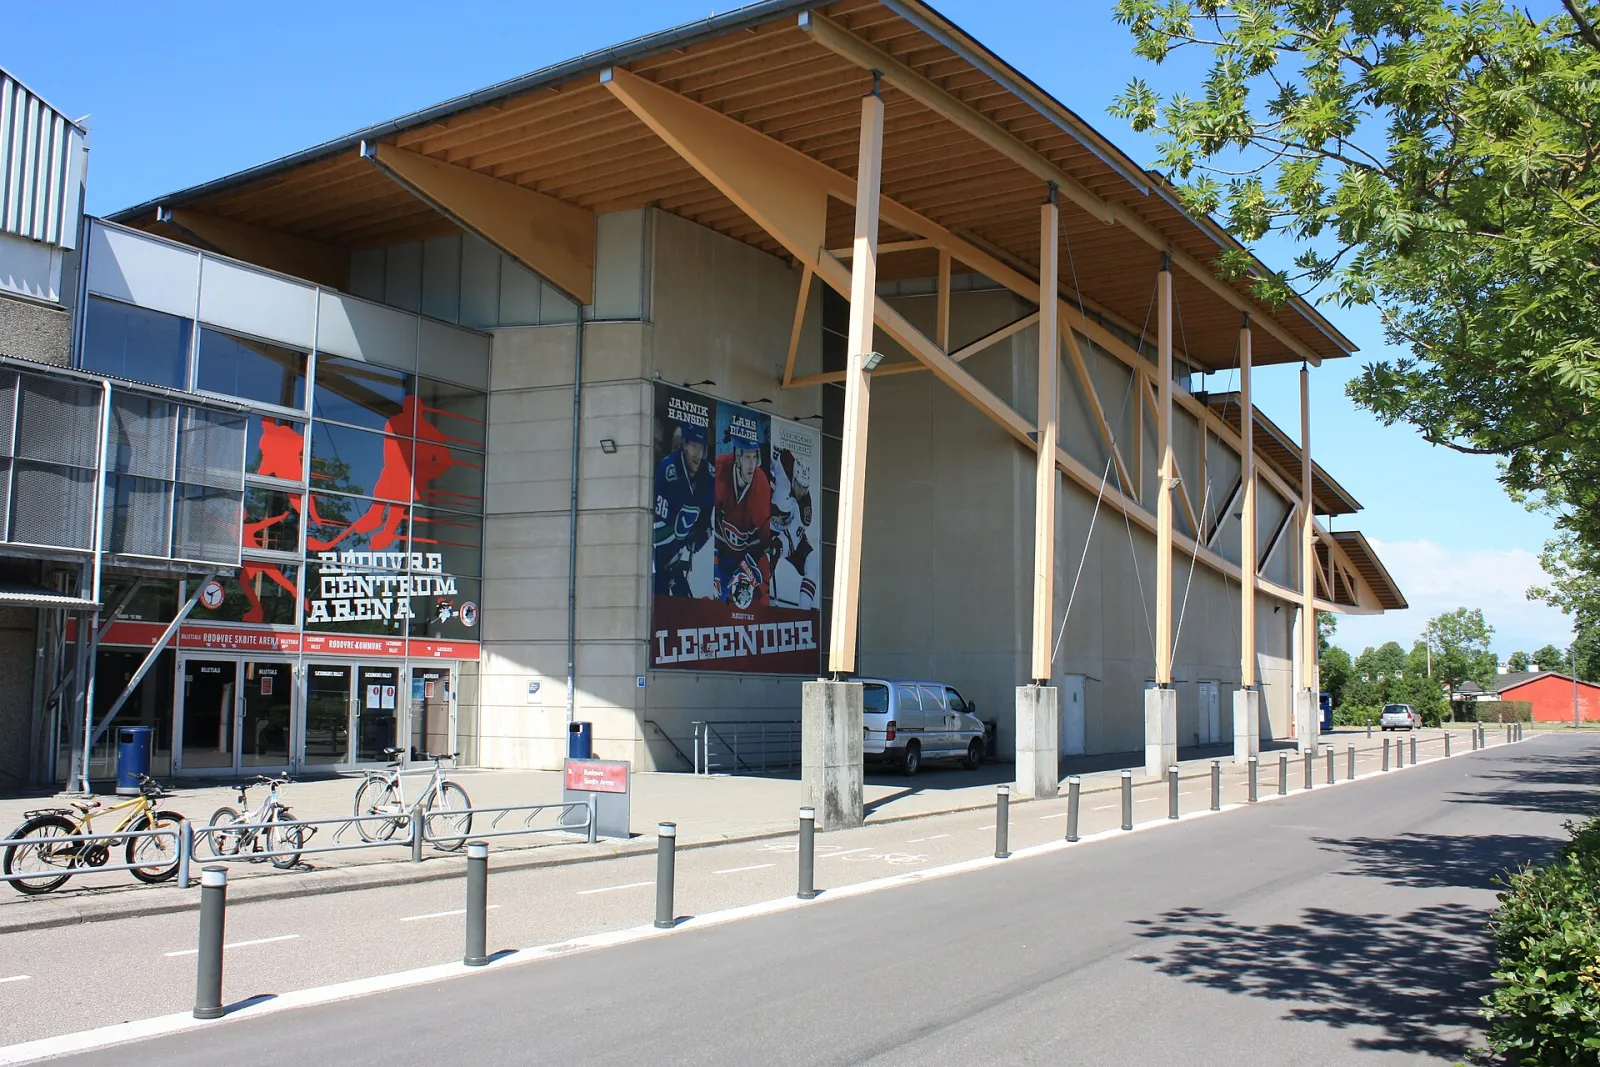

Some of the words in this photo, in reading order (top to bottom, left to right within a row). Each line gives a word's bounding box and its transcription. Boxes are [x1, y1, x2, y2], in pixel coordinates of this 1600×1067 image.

[667, 408, 709, 428] HANSEN
[668, 397, 709, 417] JANNIK
[729, 425, 758, 441] ELLER
[732, 415, 756, 430] LARS
[655, 495, 669, 519] 36
[317, 549, 443, 576] RØDOVRE
[320, 575, 458, 599] CENTRUM
[307, 598, 416, 623] ARENA
[258, 636, 279, 645] ARENA
[655, 620, 817, 664] LEGENDER
